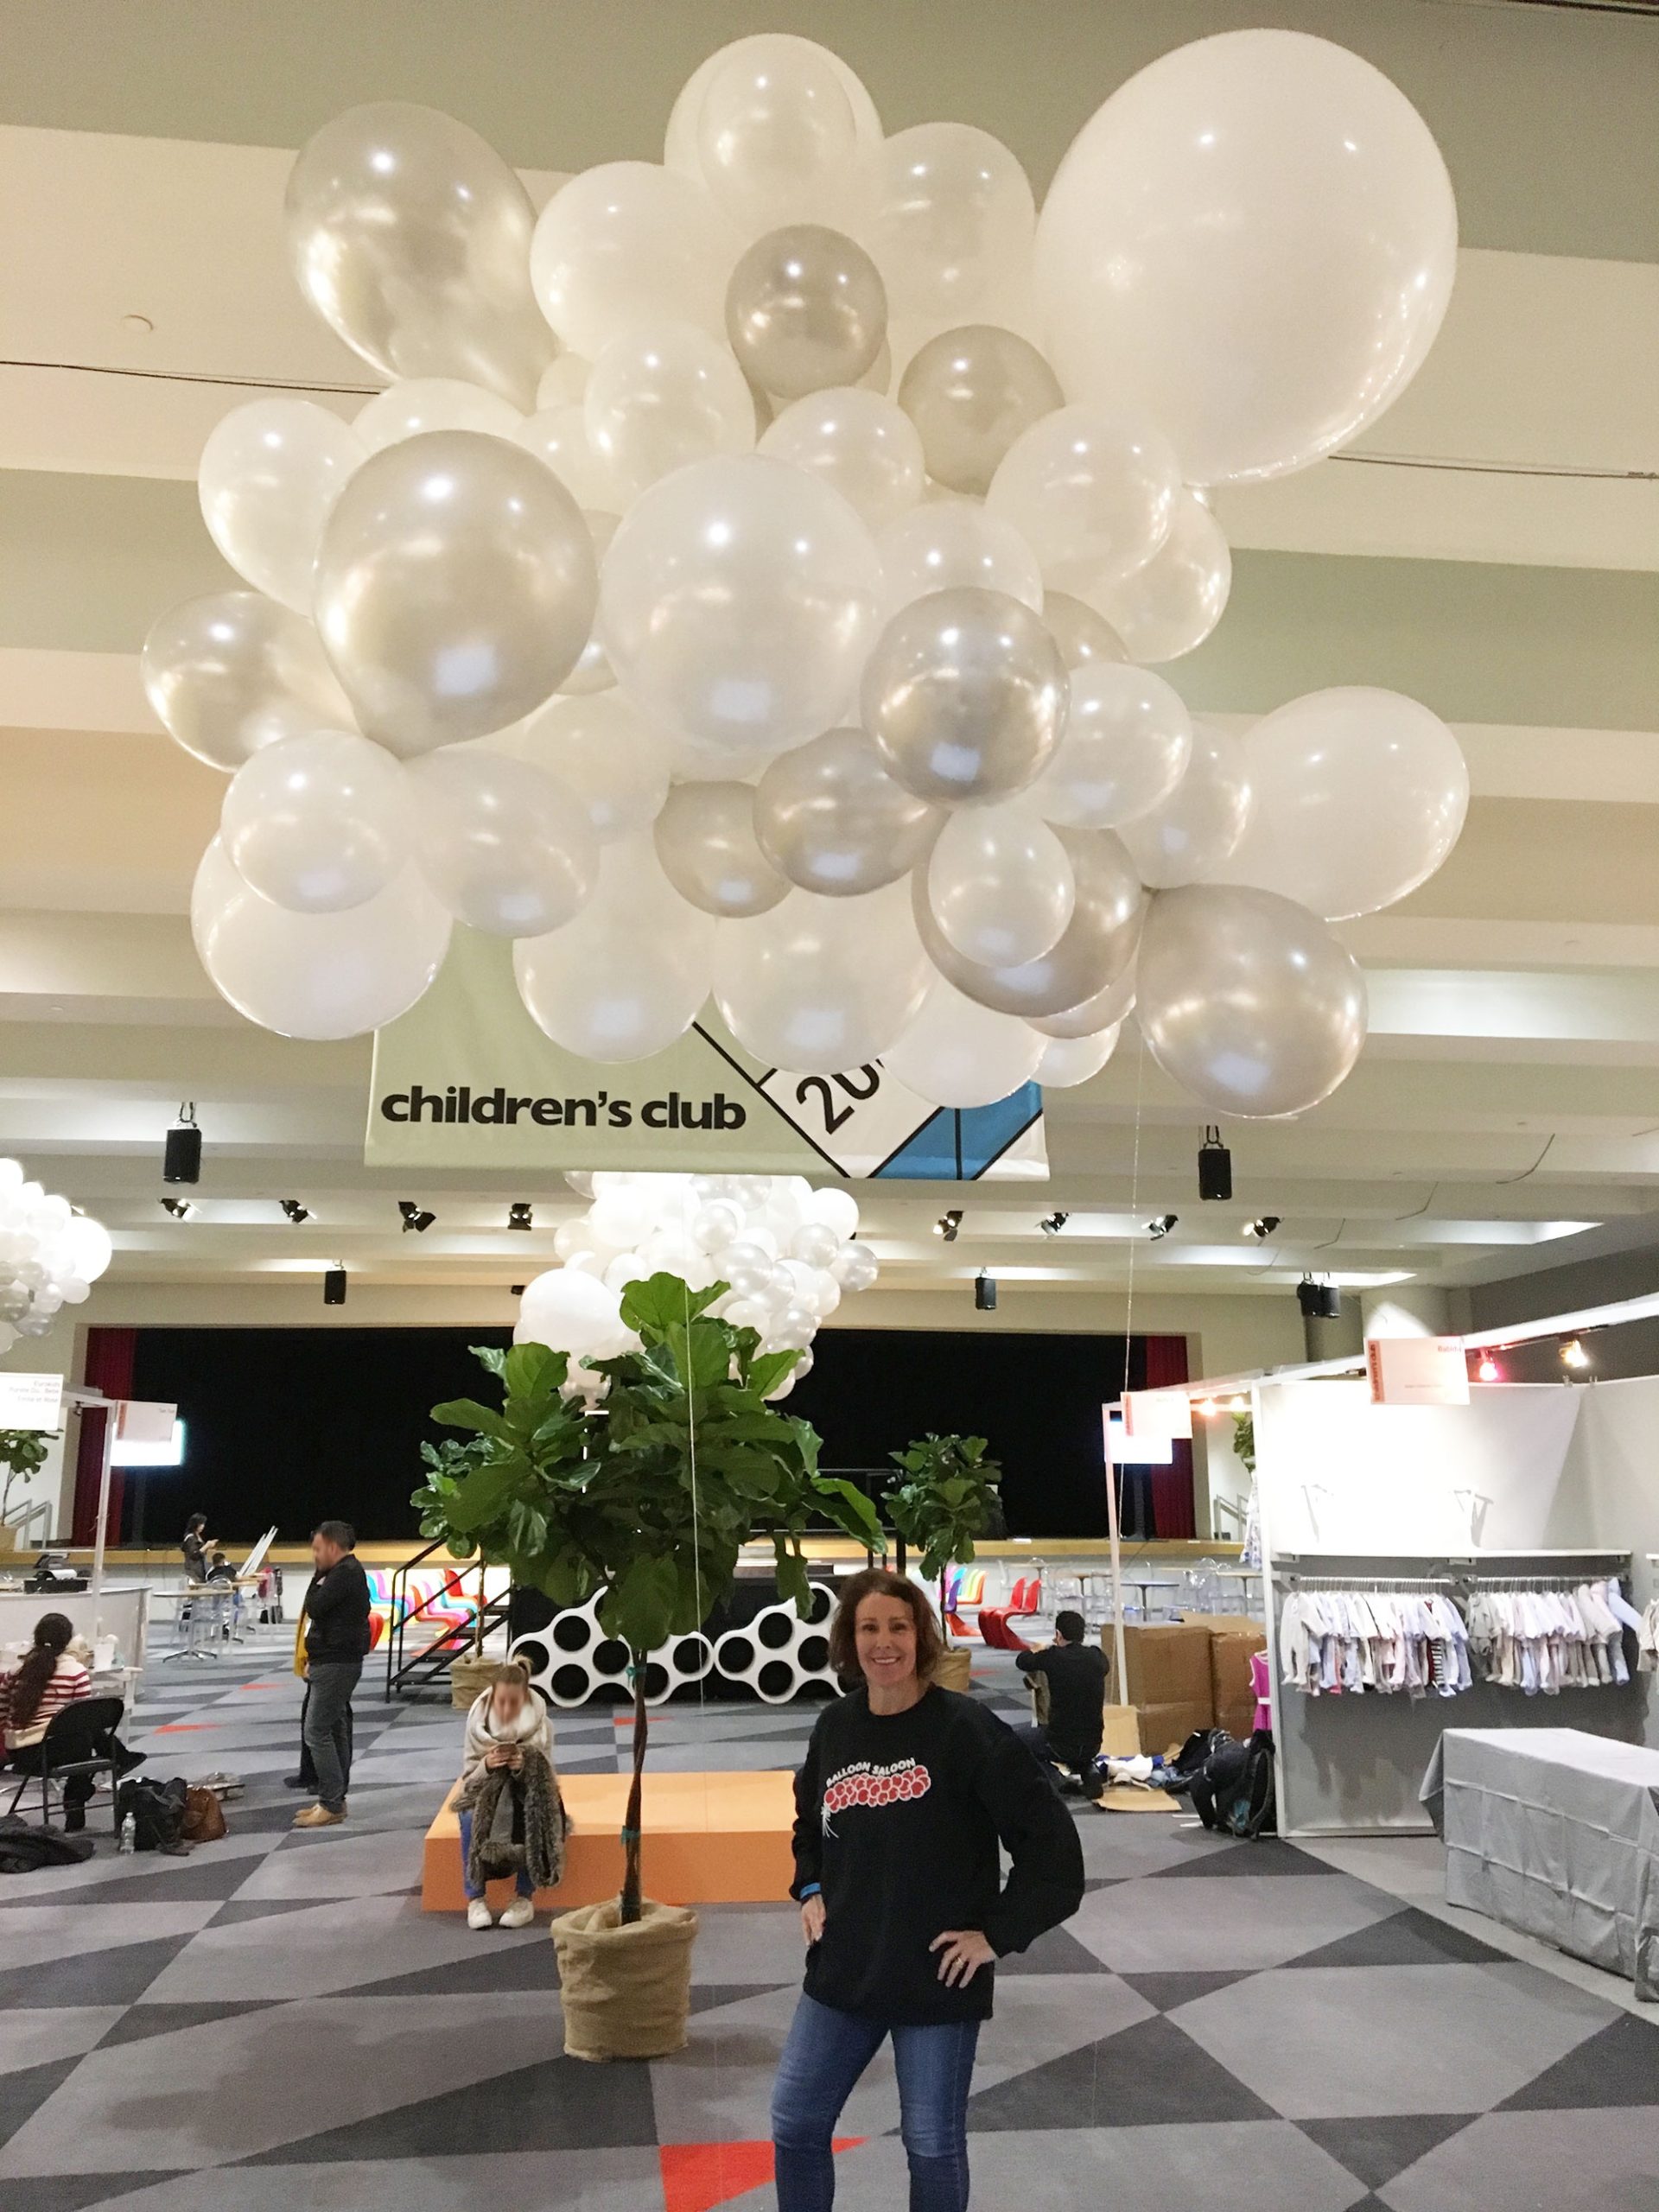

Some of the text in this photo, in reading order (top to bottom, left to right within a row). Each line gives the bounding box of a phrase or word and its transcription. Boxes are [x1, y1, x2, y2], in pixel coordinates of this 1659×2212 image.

[381, 1085, 747, 1129] children's club
[796, 1058, 885, 1135] 20
[826, 1757, 916, 1788] BALLOON SALOON
